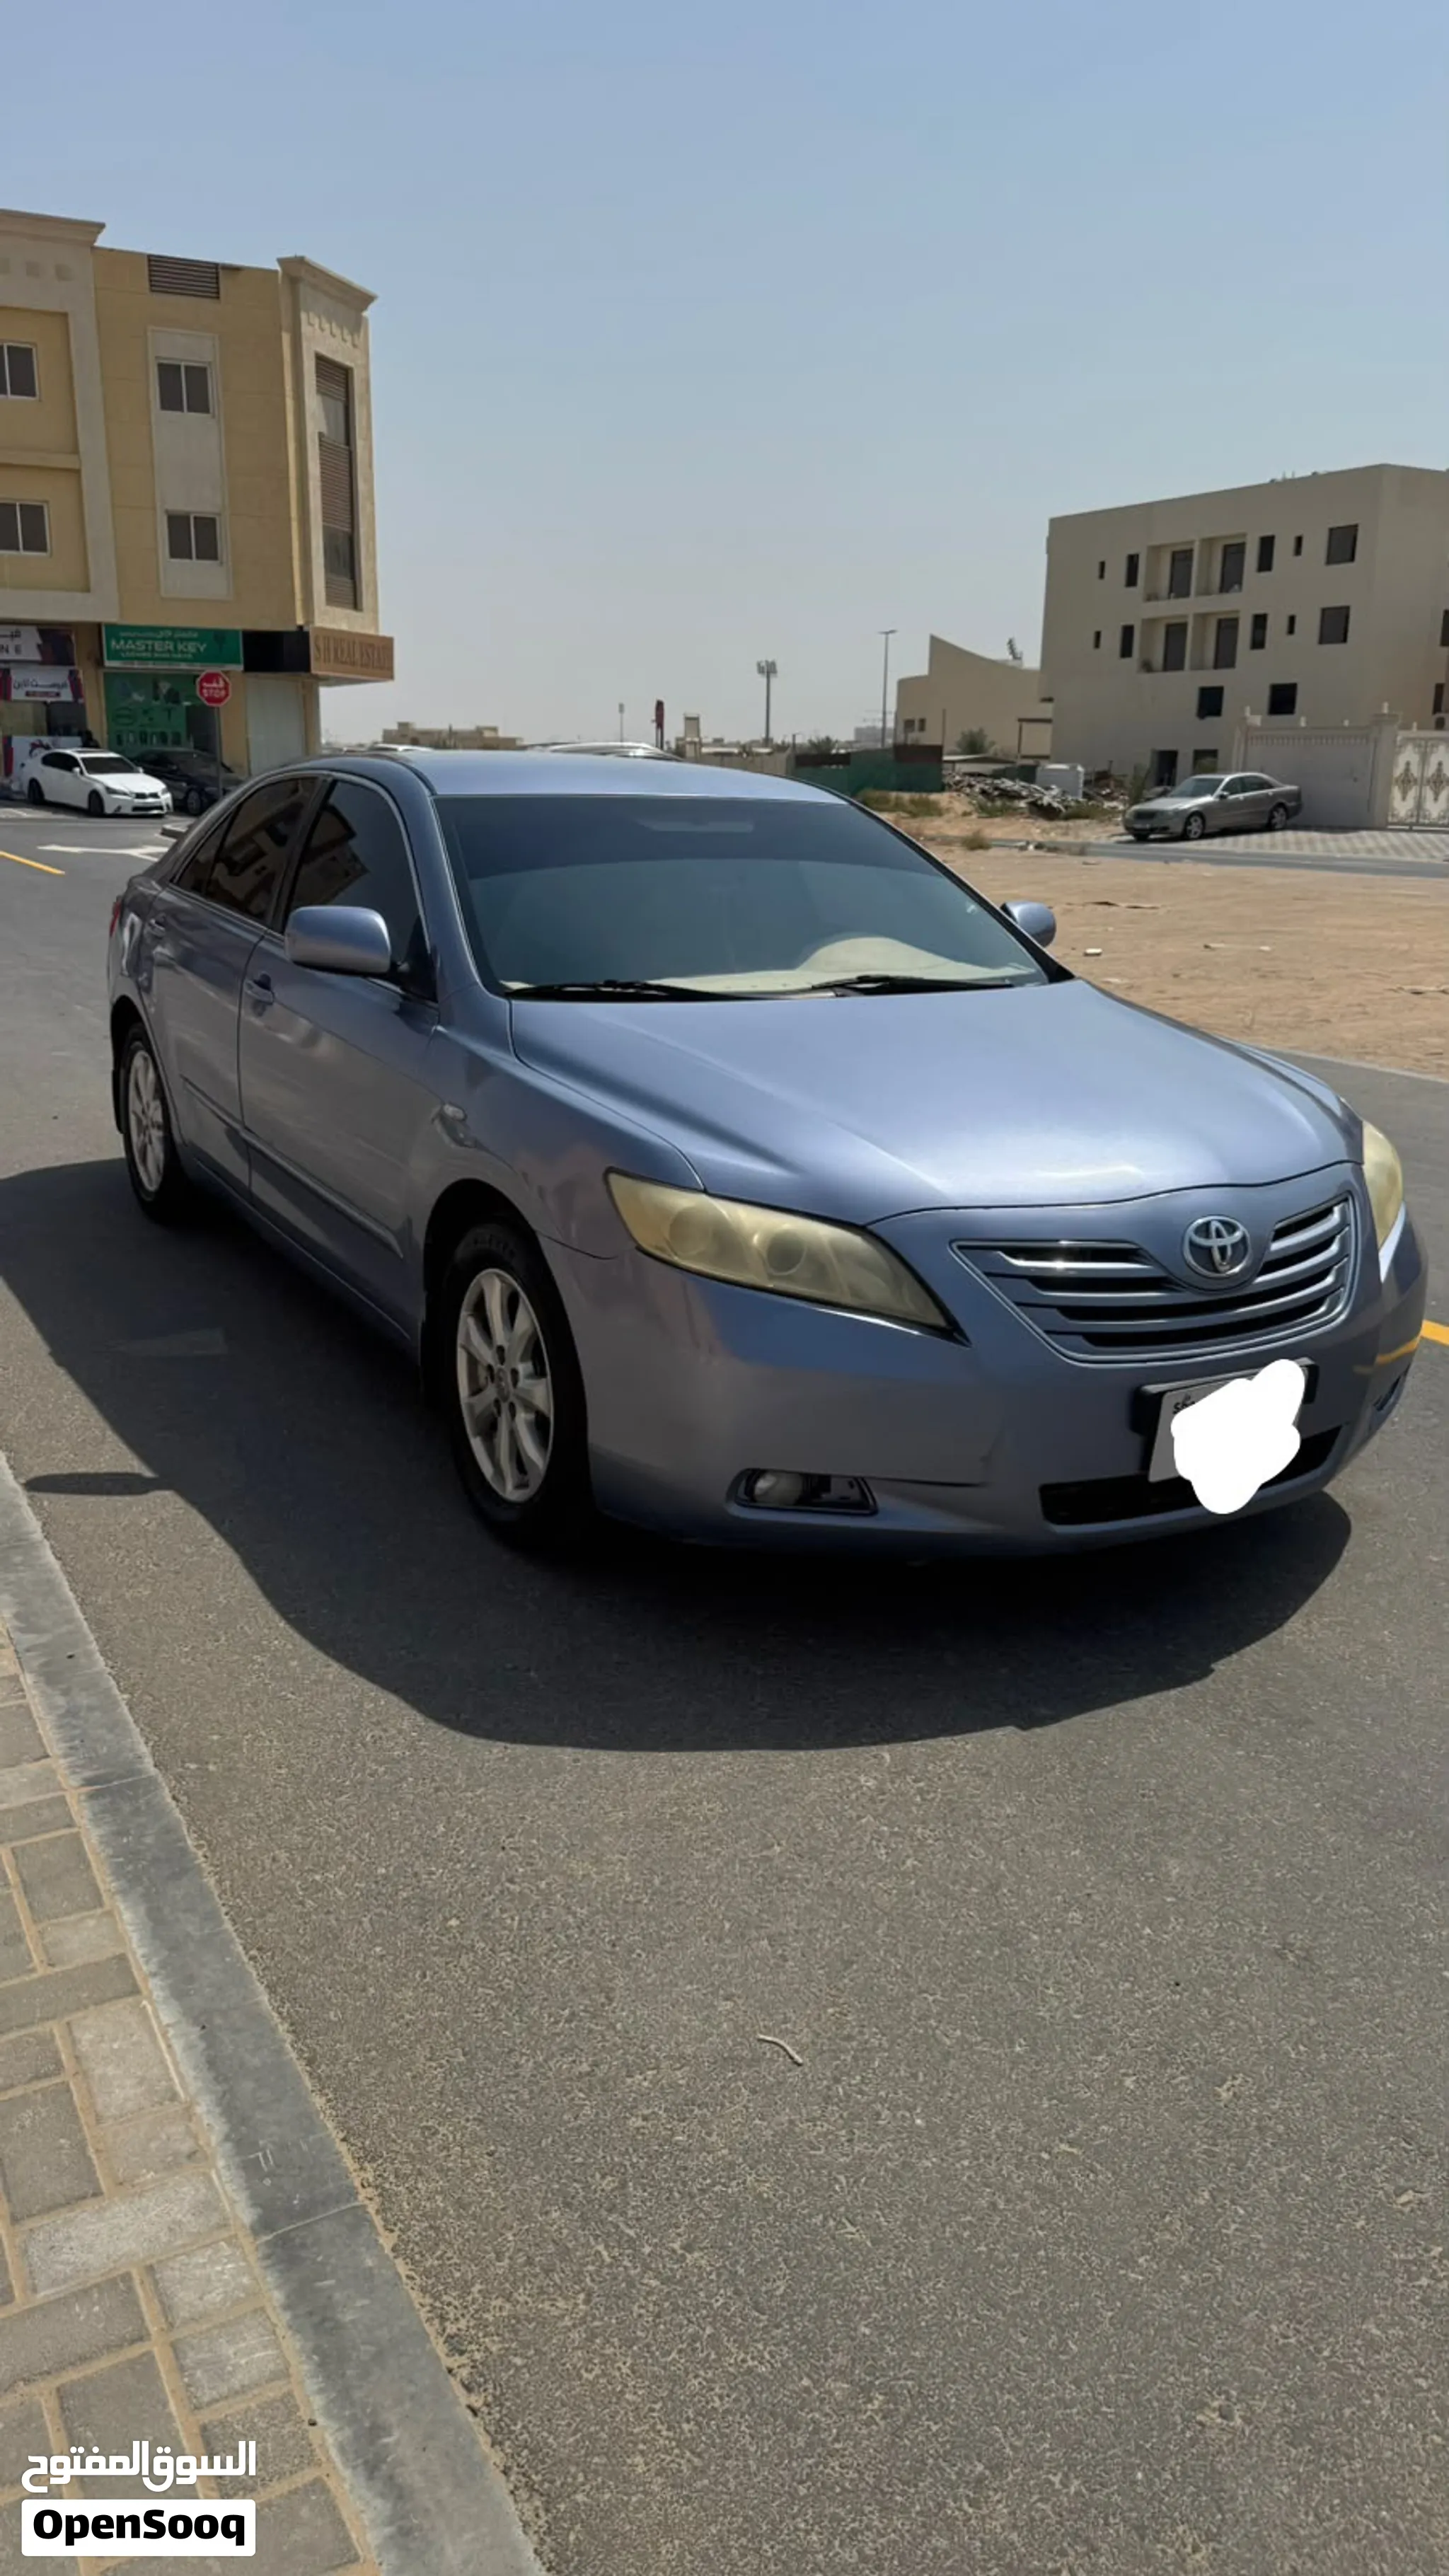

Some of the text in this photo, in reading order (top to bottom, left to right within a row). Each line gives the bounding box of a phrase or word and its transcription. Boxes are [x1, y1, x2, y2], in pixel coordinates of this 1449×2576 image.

[111, 638, 207, 653] MASTER KEY
[202, 688, 226, 698] STOP
